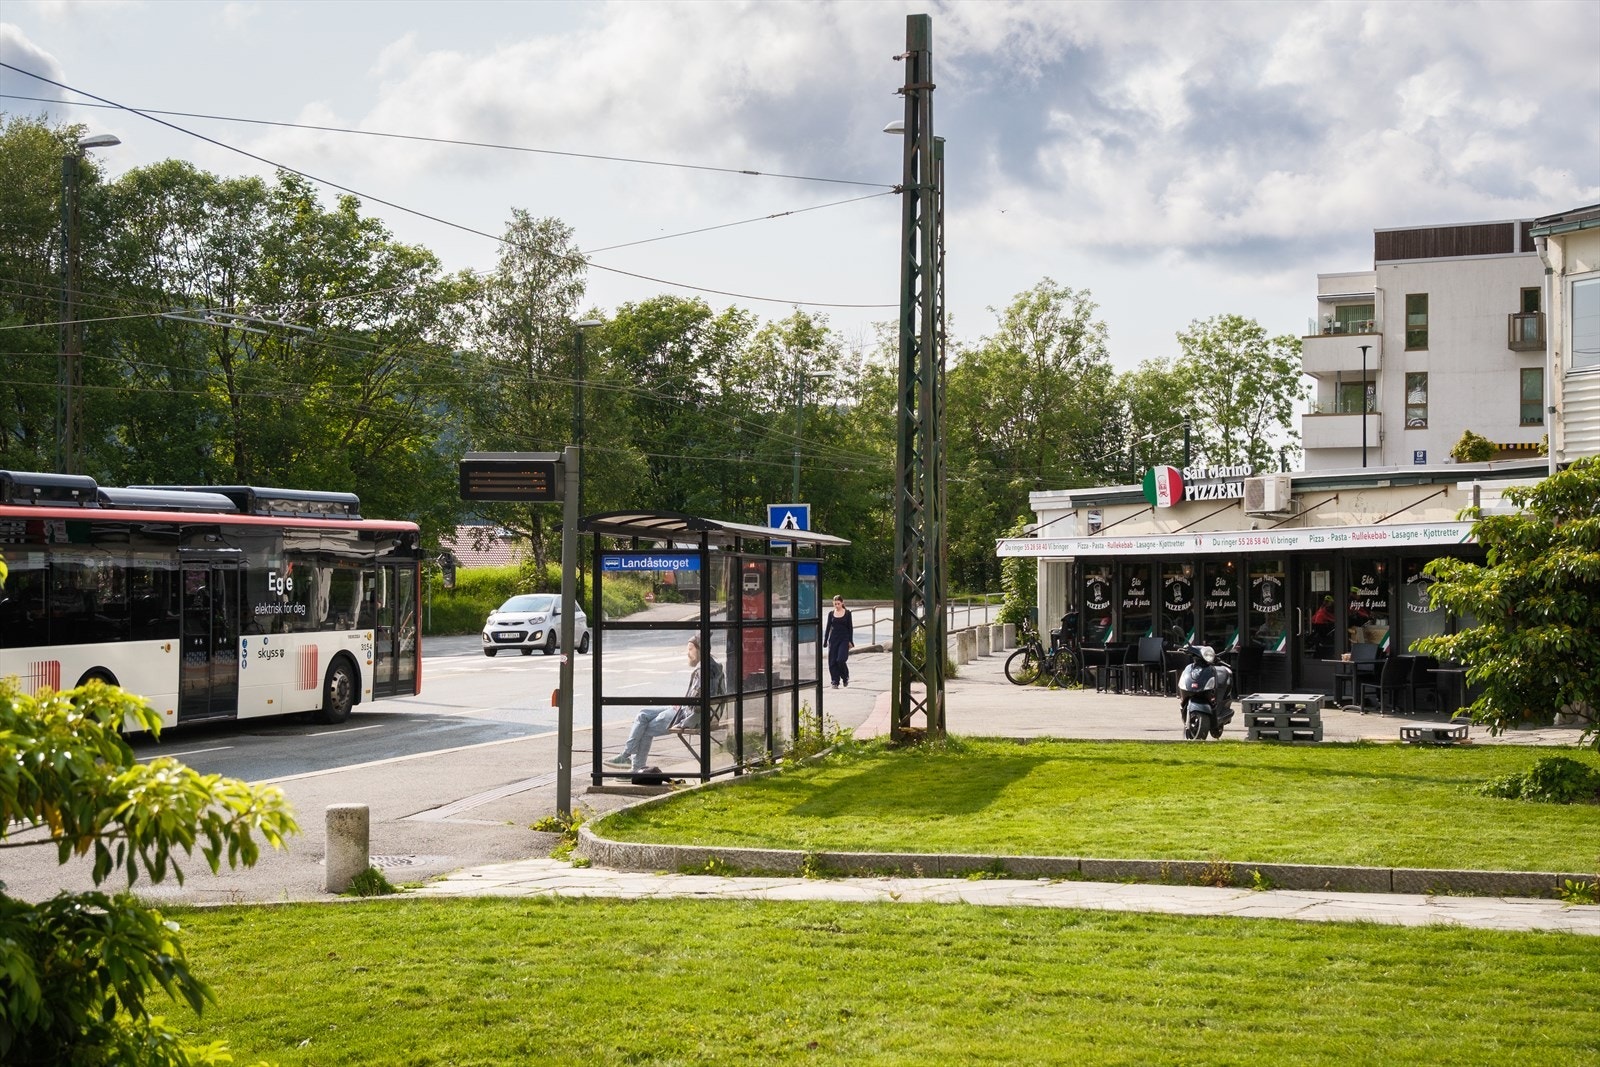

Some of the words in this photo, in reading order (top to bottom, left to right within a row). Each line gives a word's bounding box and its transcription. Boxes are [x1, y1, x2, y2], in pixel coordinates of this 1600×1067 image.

[1183, 466, 1206, 480] San
[1208, 464, 1252, 478] Marino
[1185, 482, 1244, 501] PIZZERI
[1222, 538, 1237, 547] ringer
[1276, 536, 1298, 545] bringer
[1310, 534, 1324, 543] Pizza
[1352, 531, 1386, 540] Rullekebab
[1392, 531, 1418, 541] Lasagne
[1424, 528, 1459, 538] Kjøttretter
[1053, 543, 1069, 551] bringer
[1136, 541, 1156, 549] Lasagne
[1159, 540, 1185, 549] Kjøttretter
[622, 557, 689, 569] Landåstorget
[1253, 578, 1262, 588] San
[1362, 574, 1374, 585] Ekte
[255, 602, 283, 614] elektrisk
[284, 602, 293, 614] for
[294, 602, 305, 616] deg
[1087, 600, 1110, 610] PIZZERIA
[1166, 601, 1191, 611] PIZZERIA
[1253, 602, 1282, 612] PIZZERIA
[1350, 600, 1364, 610] pizza
[1371, 600, 1386, 610] pasta
[258, 648, 279, 660] skyss
